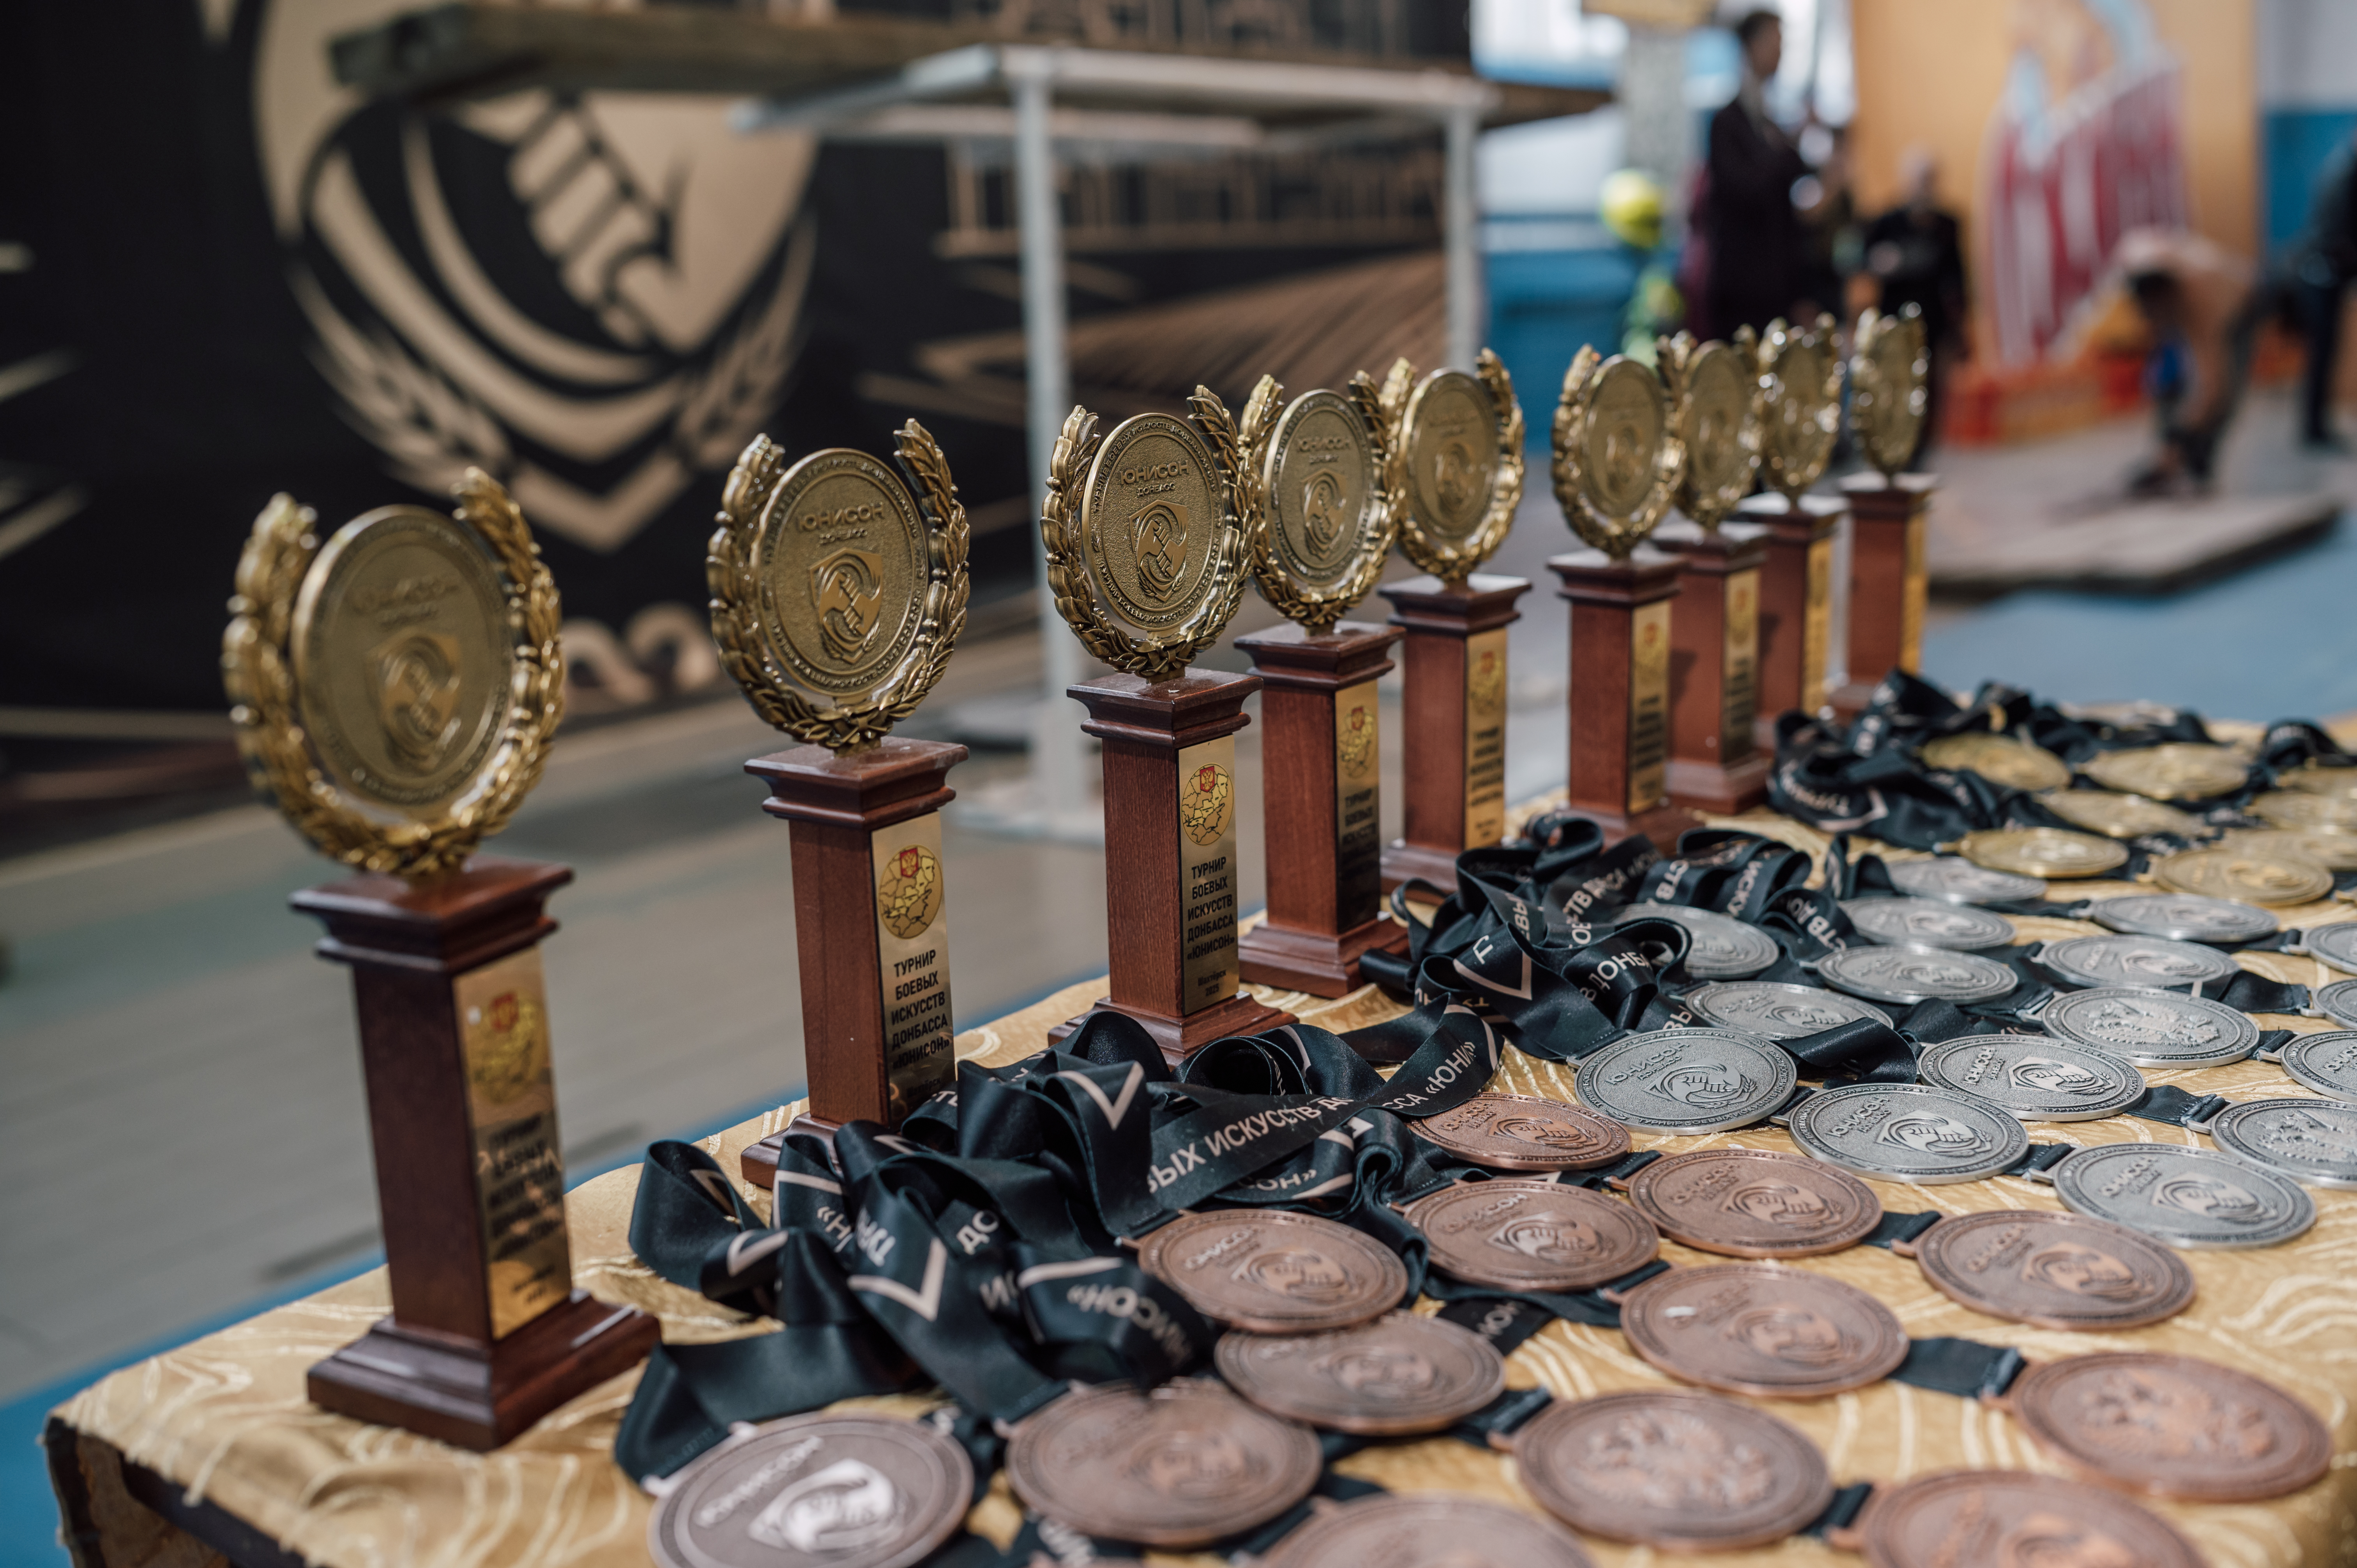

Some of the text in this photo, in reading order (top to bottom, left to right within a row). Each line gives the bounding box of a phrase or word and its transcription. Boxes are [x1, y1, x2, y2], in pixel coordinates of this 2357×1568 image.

[1120, 459, 1189, 485] ЮНИСОН
[1138, 482, 1176, 497] ДОНБАСС
[798, 502, 885, 532] ЮНИСОН
[1191, 856, 1226, 880] ТУРНИР
[1192, 875, 1228, 901] БОЕВЫХ
[1187, 894, 1232, 922] ИСКУССТВ
[1187, 913, 1234, 944] ДОНБАССА
[1187, 933, 1235, 960] «ЮНИСОН»
[894, 949, 936, 978] ТУРНИР
[895, 970, 939, 1001] БОЕВЫХ
[1205, 983, 1220, 997] 2025
[891, 991, 945, 1026] ИСКУССТВ
[892, 1013, 949, 1051] ДОНБАССА
[892, 1036, 950, 1070] «ЮНИСОН»
[1604, 1042, 1690, 1085] ЮНИСОН
[1638, 1054, 1683, 1081] ДОНБАСС
[1962, 1046, 1997, 1086] ЮНИСОН
[1583, 1063, 1598, 1086] БОЕВЫХ
[1583, 1086, 1603, 1108] ТУРНИР
[1639, 1118, 1682, 1127] ТУРНИР
[1684, 1114, 1733, 1126] БОЕВЫХ
[1774, 1062, 1788, 1094] ДОНБАССА
[2045, 1104, 2088, 1112] ТУРНИР
[1439, 1101, 1493, 1131] ЮНИСОН
[1825, 1096, 1892, 1137] ЮНИСОН
[1859, 1109, 1891, 1133] ДОНБАСС
[1204, 1106, 1322, 1158] ИСКУССТВ
[1665, 1160, 1741, 1205] ЮНИСОН
[2097, 1155, 2159, 1199] ЮНИСОН
